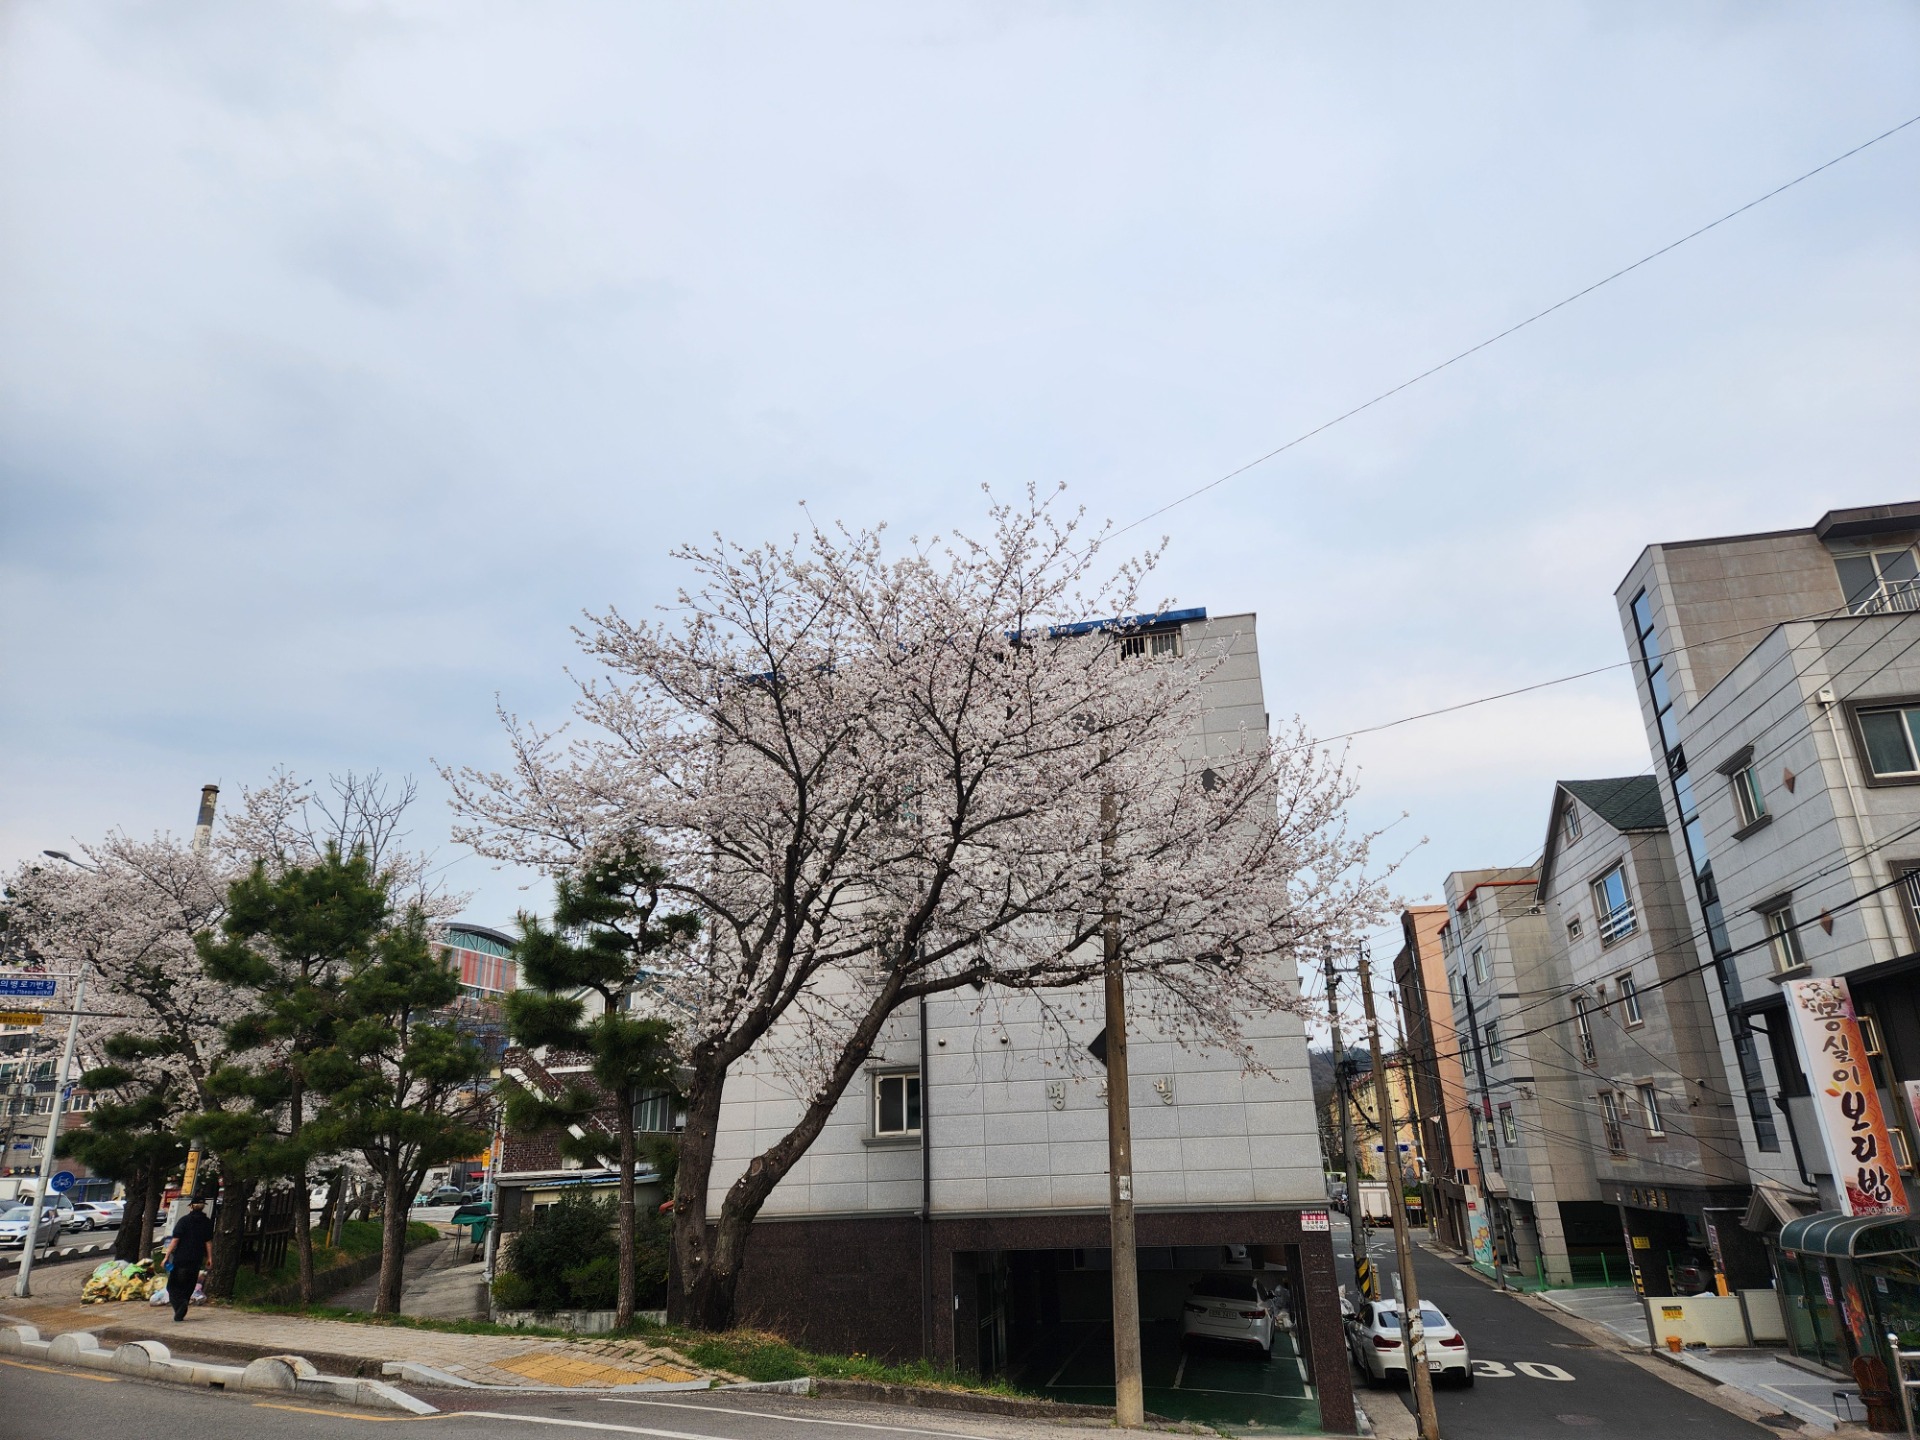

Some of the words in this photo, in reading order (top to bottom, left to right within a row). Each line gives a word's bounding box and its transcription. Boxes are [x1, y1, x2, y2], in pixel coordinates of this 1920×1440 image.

[1814, 1002, 1860, 1085] 몽실이
[1841, 1091, 1891, 1201] 보리밥
[1470, 1359, 1576, 1381] 30
